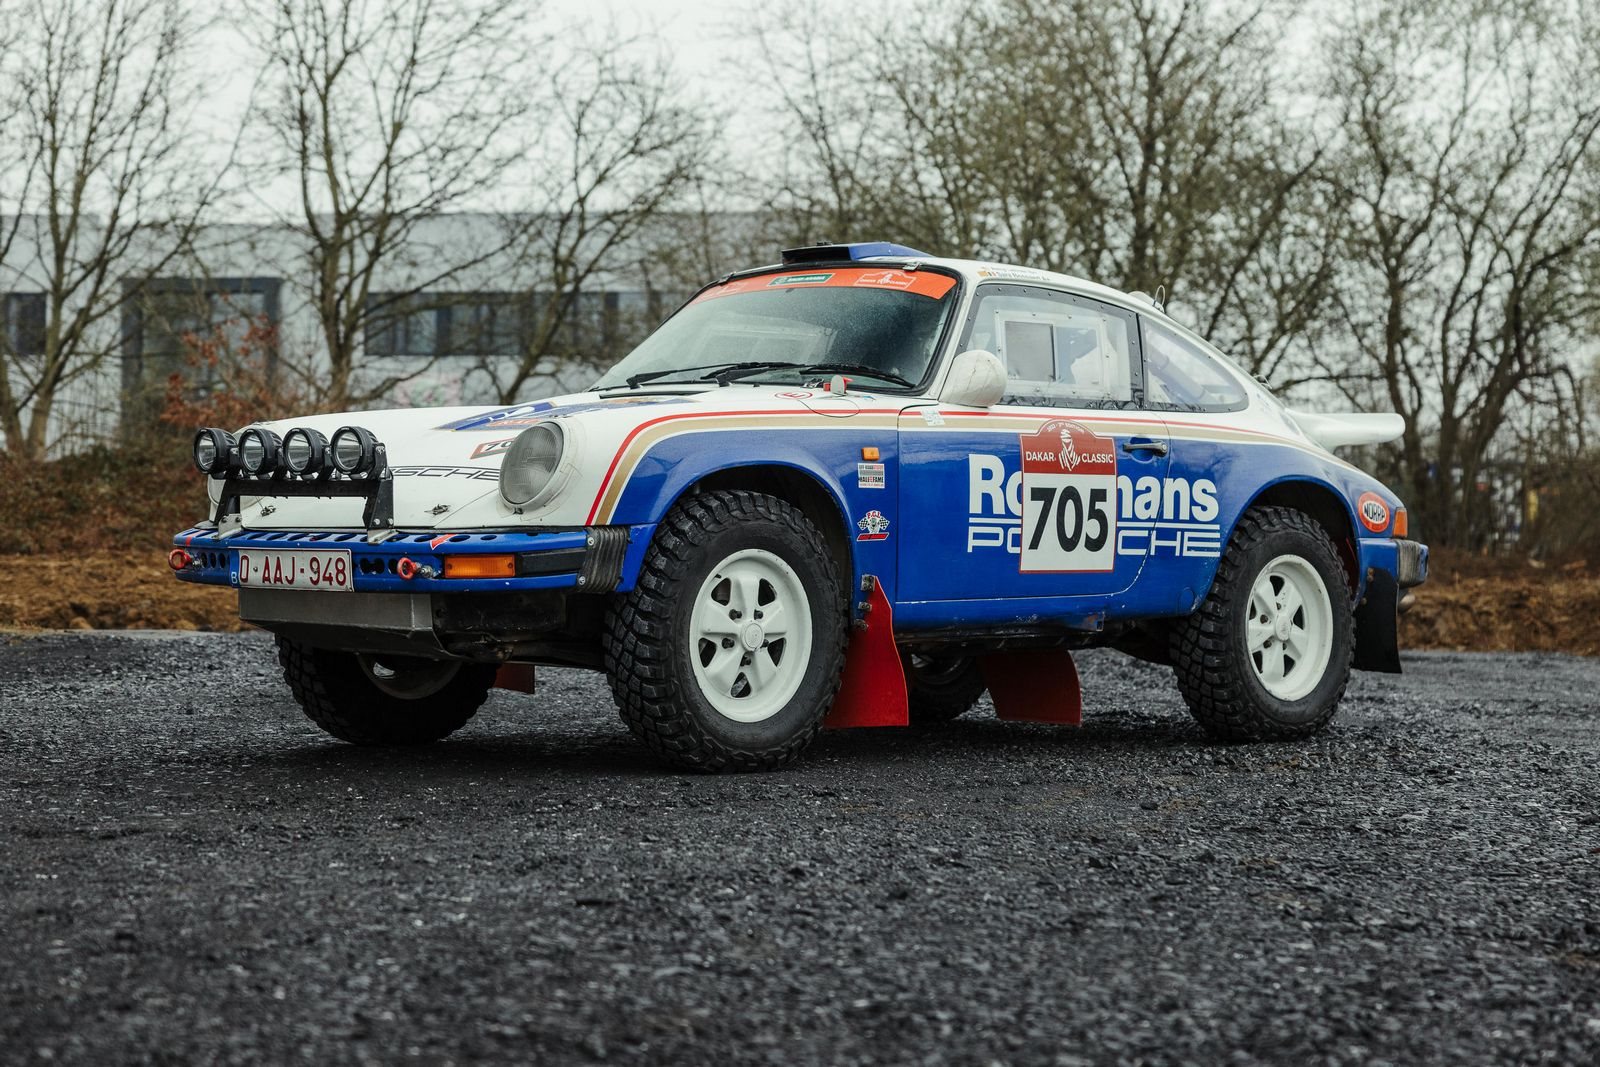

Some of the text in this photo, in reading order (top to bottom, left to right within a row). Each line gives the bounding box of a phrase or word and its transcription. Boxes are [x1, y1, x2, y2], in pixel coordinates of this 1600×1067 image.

[1025, 451, 1114, 463] DAKAR CLASSIC
[387, 467, 500, 481] SCHE
[968, 453, 1219, 522] Roans
[1028, 485, 1109, 553] 705
[967, 526, 1221, 557] PCHE
[231, 571, 238, 584] B
